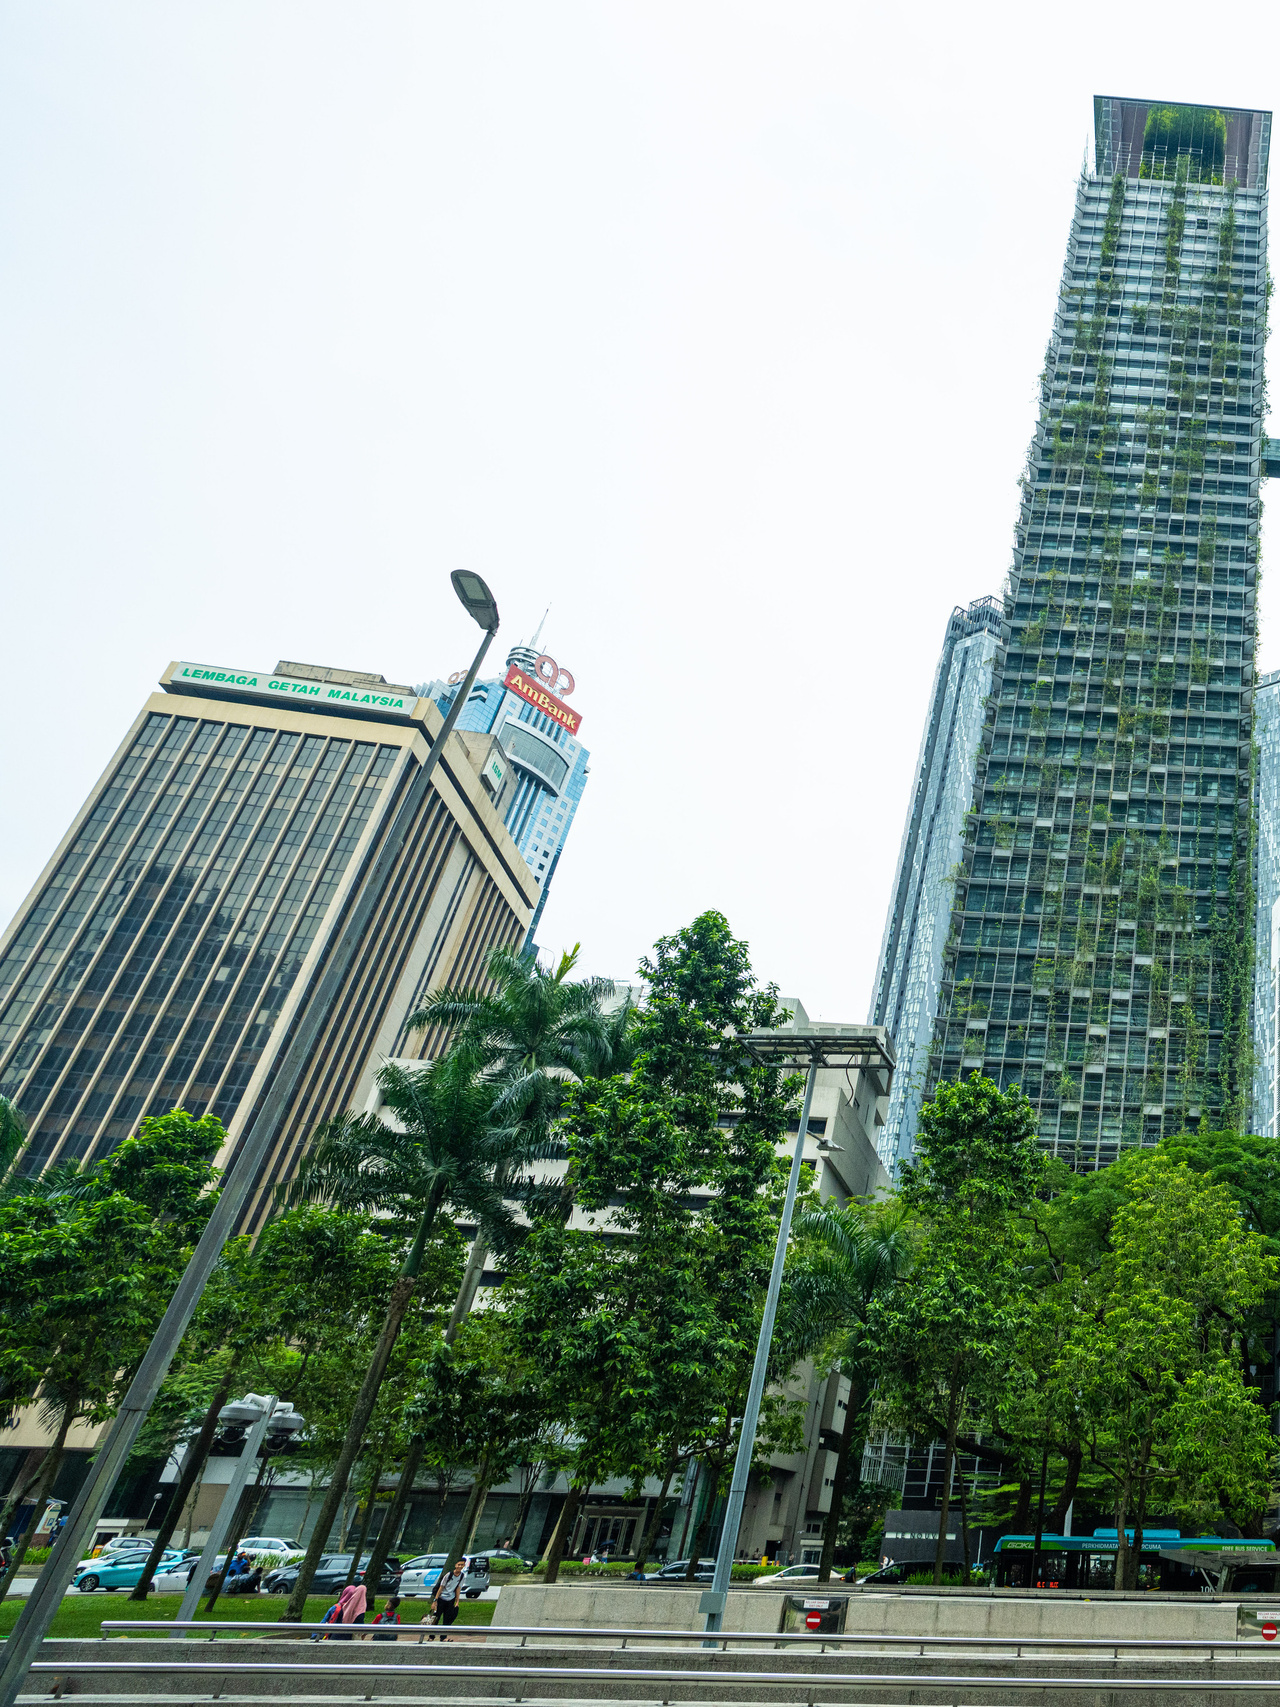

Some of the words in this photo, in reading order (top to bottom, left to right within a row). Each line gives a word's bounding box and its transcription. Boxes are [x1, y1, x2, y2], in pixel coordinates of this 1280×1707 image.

[181, 667, 258, 687] LEMBAGA
[267, 680, 321, 696] GETAH
[327, 688, 404, 708] MALAYSIA
[510, 674, 577, 730] AmBank
